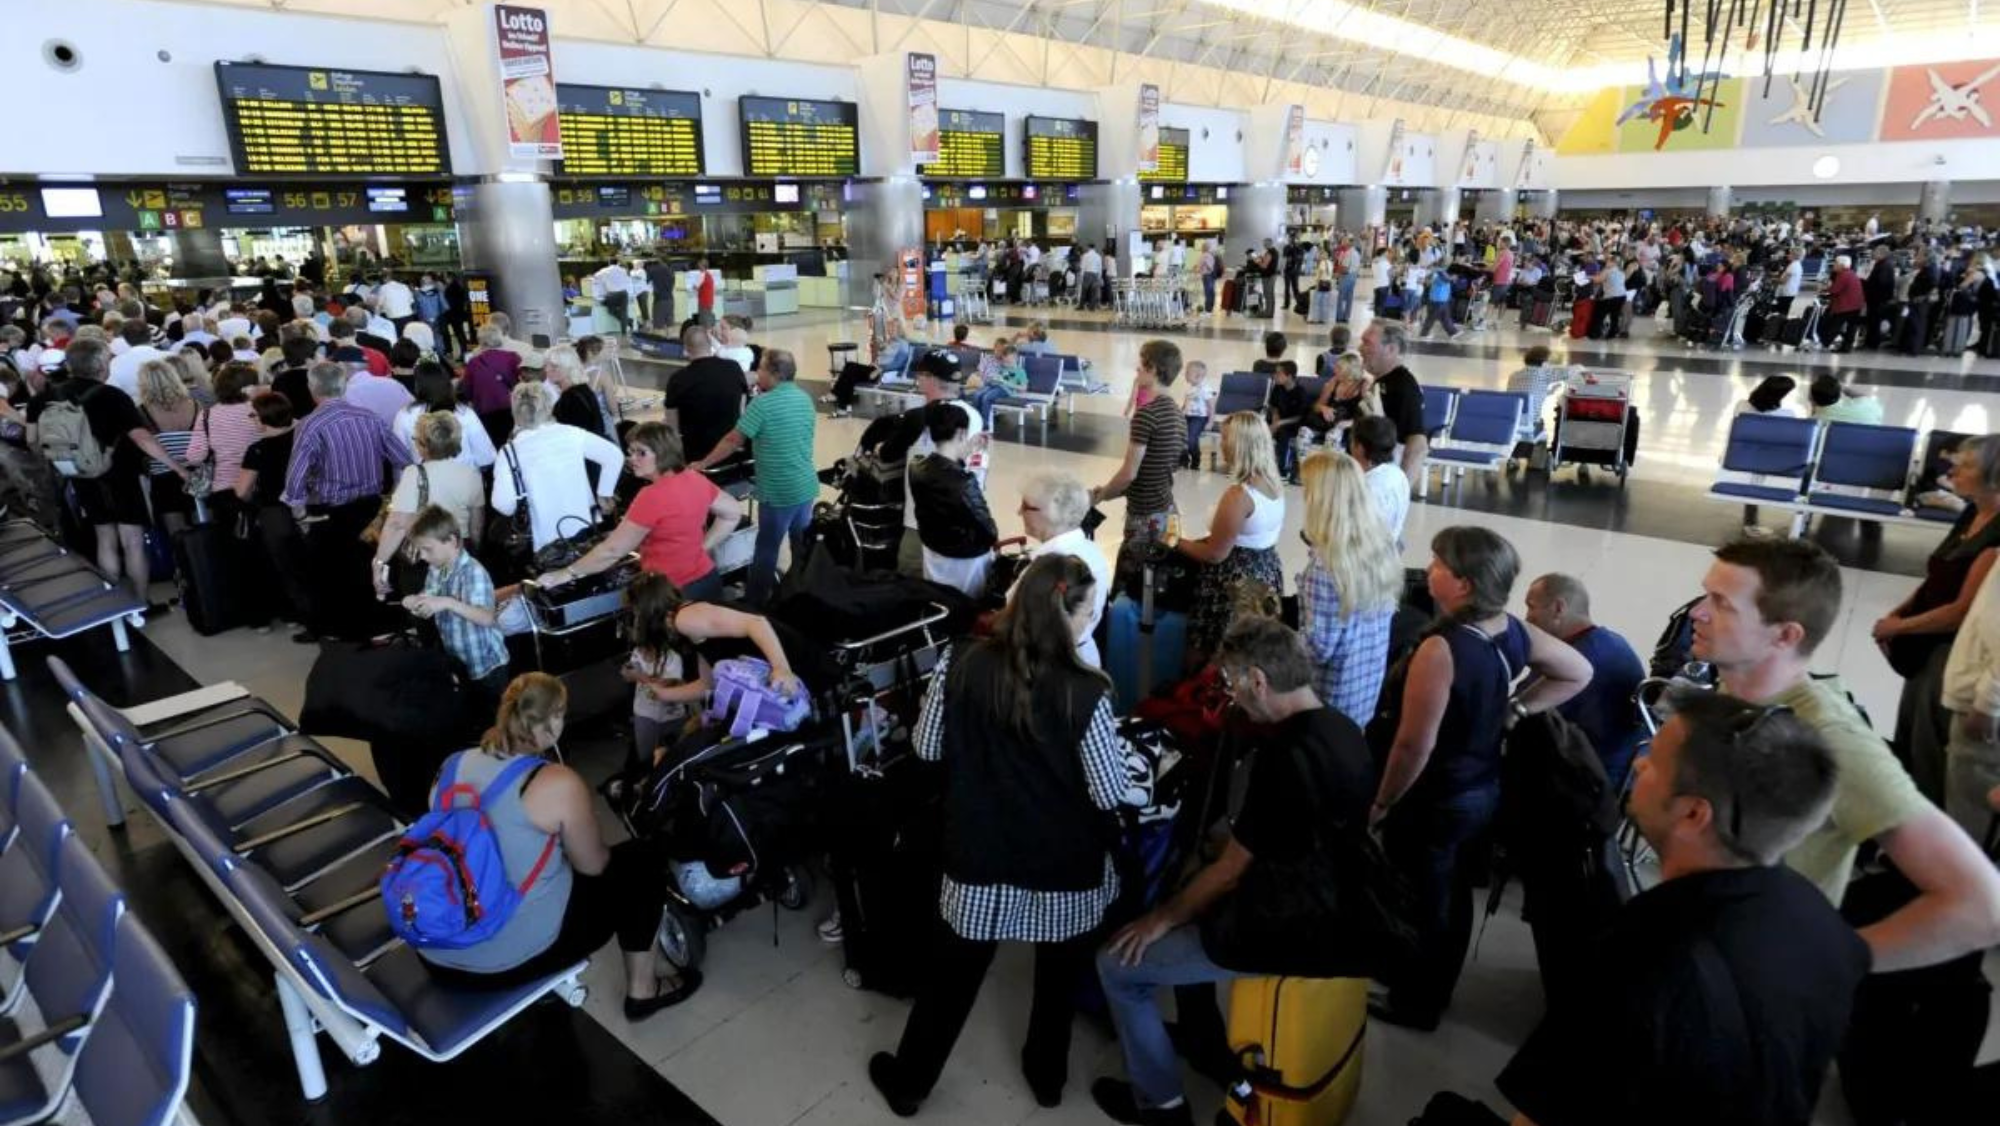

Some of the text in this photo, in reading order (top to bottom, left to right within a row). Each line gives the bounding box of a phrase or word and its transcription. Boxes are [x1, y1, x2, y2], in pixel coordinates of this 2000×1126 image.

[501, 9, 543, 32] Lotto
[911, 55, 934, 70] Lotto
[0, 194, 28, 212] 55
[284, 193, 306, 209] 56
[338, 192, 356, 207] 57
[144, 212, 198, 227] A B C
[435, 207, 447, 220] A
[468, 291, 489, 302] ONE
